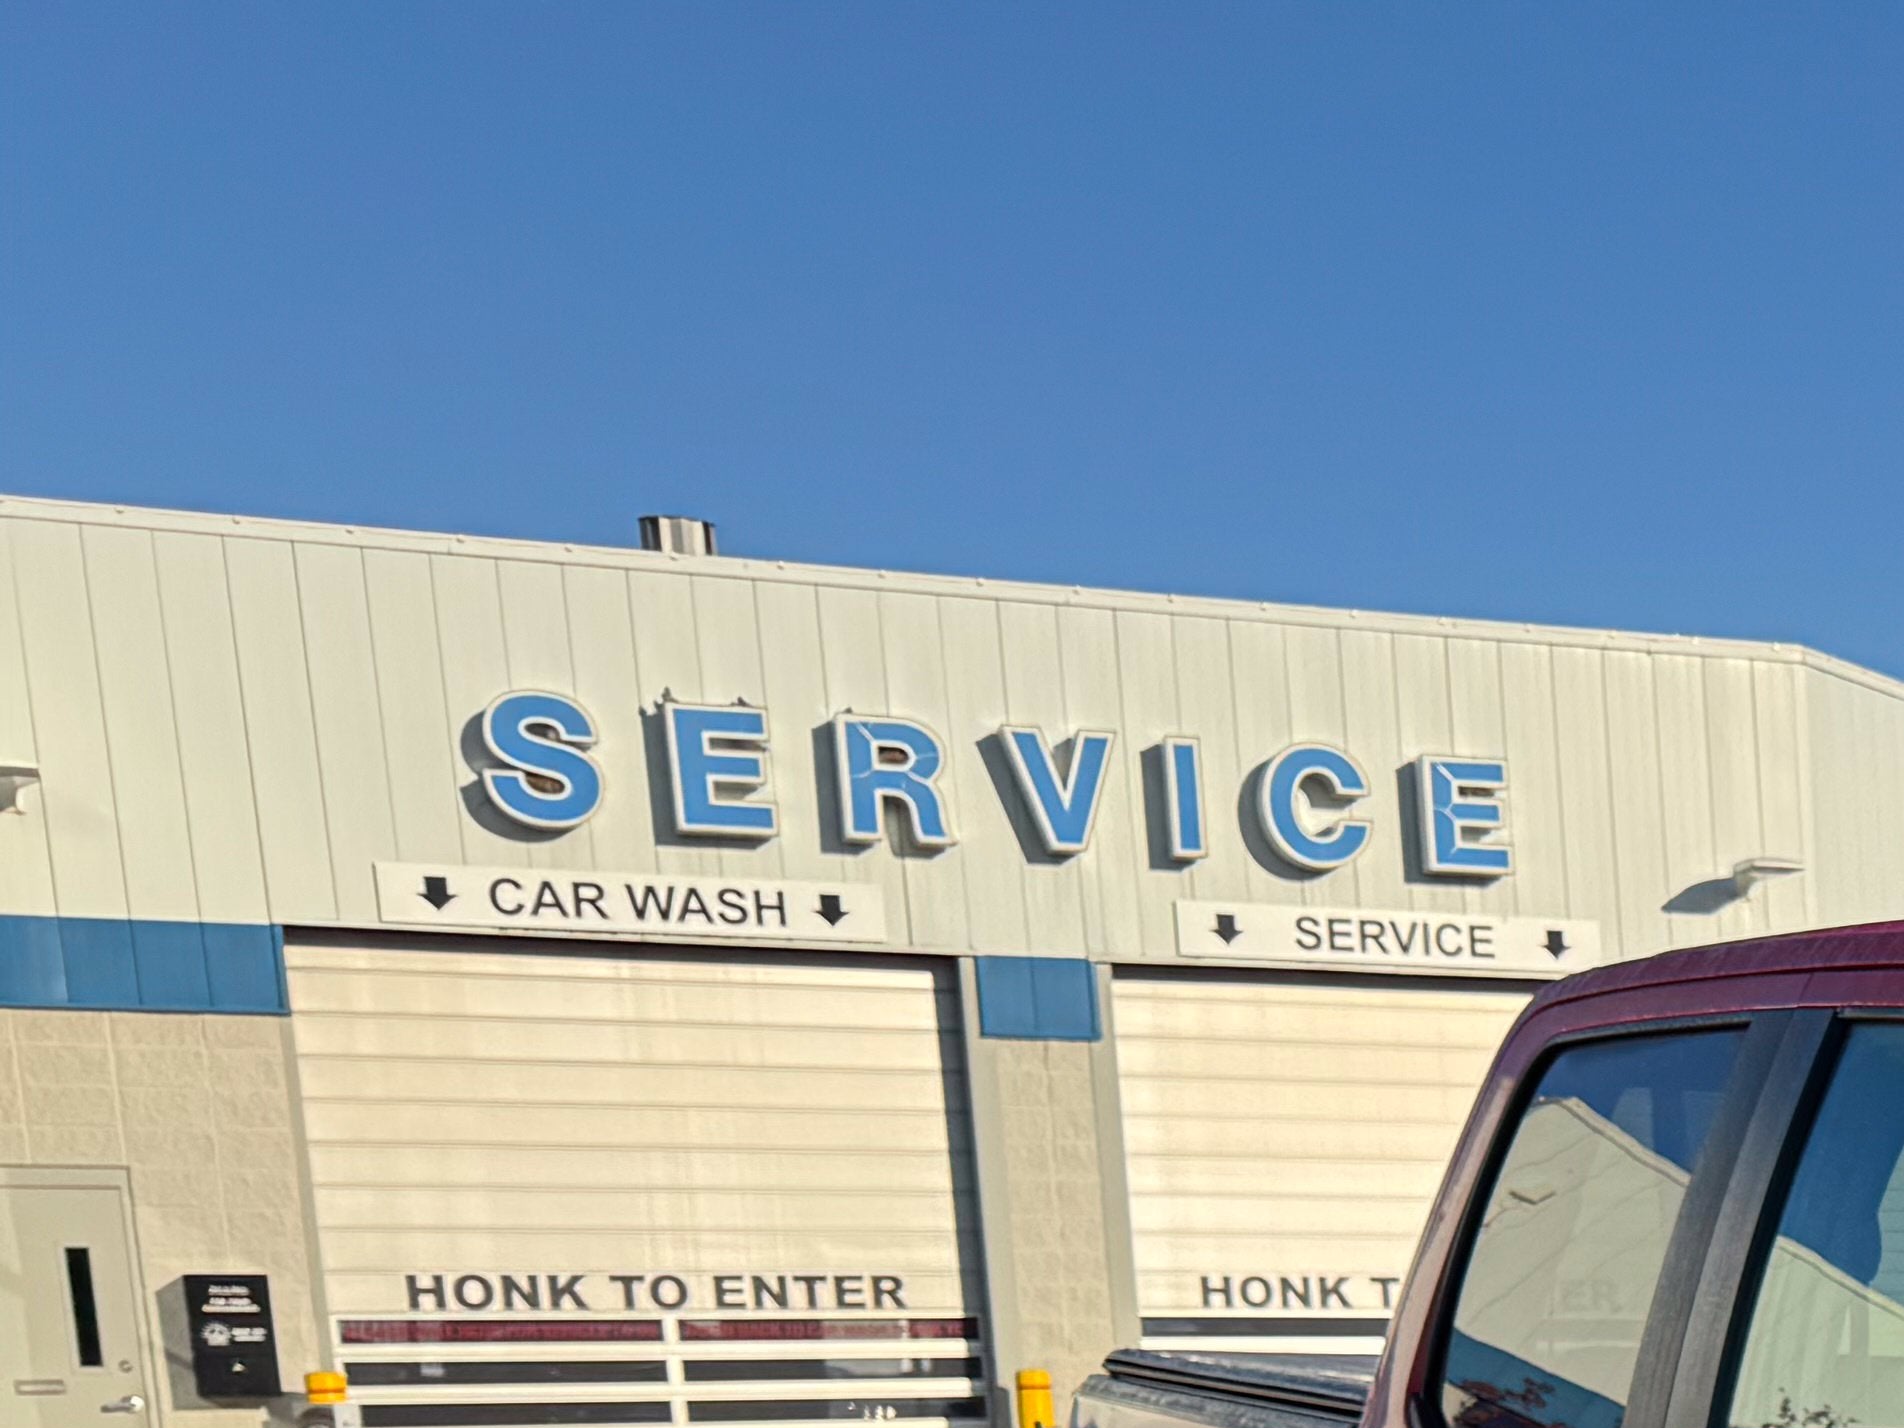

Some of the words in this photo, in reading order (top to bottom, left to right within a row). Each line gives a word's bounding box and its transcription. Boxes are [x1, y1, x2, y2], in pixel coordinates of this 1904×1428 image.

[478, 687, 1516, 877] SERVICE
[489, 876, 611, 922] CAR
[625, 882, 789, 929] WASH
[1293, 913, 1498, 961] SERVICE
[405, 1274, 590, 1311] HONK
[609, 1275, 689, 1310] TO
[713, 1274, 909, 1310] ENTER
[1200, 1275, 1353, 1309] HONK
[1370, 1276, 1401, 1309] T
